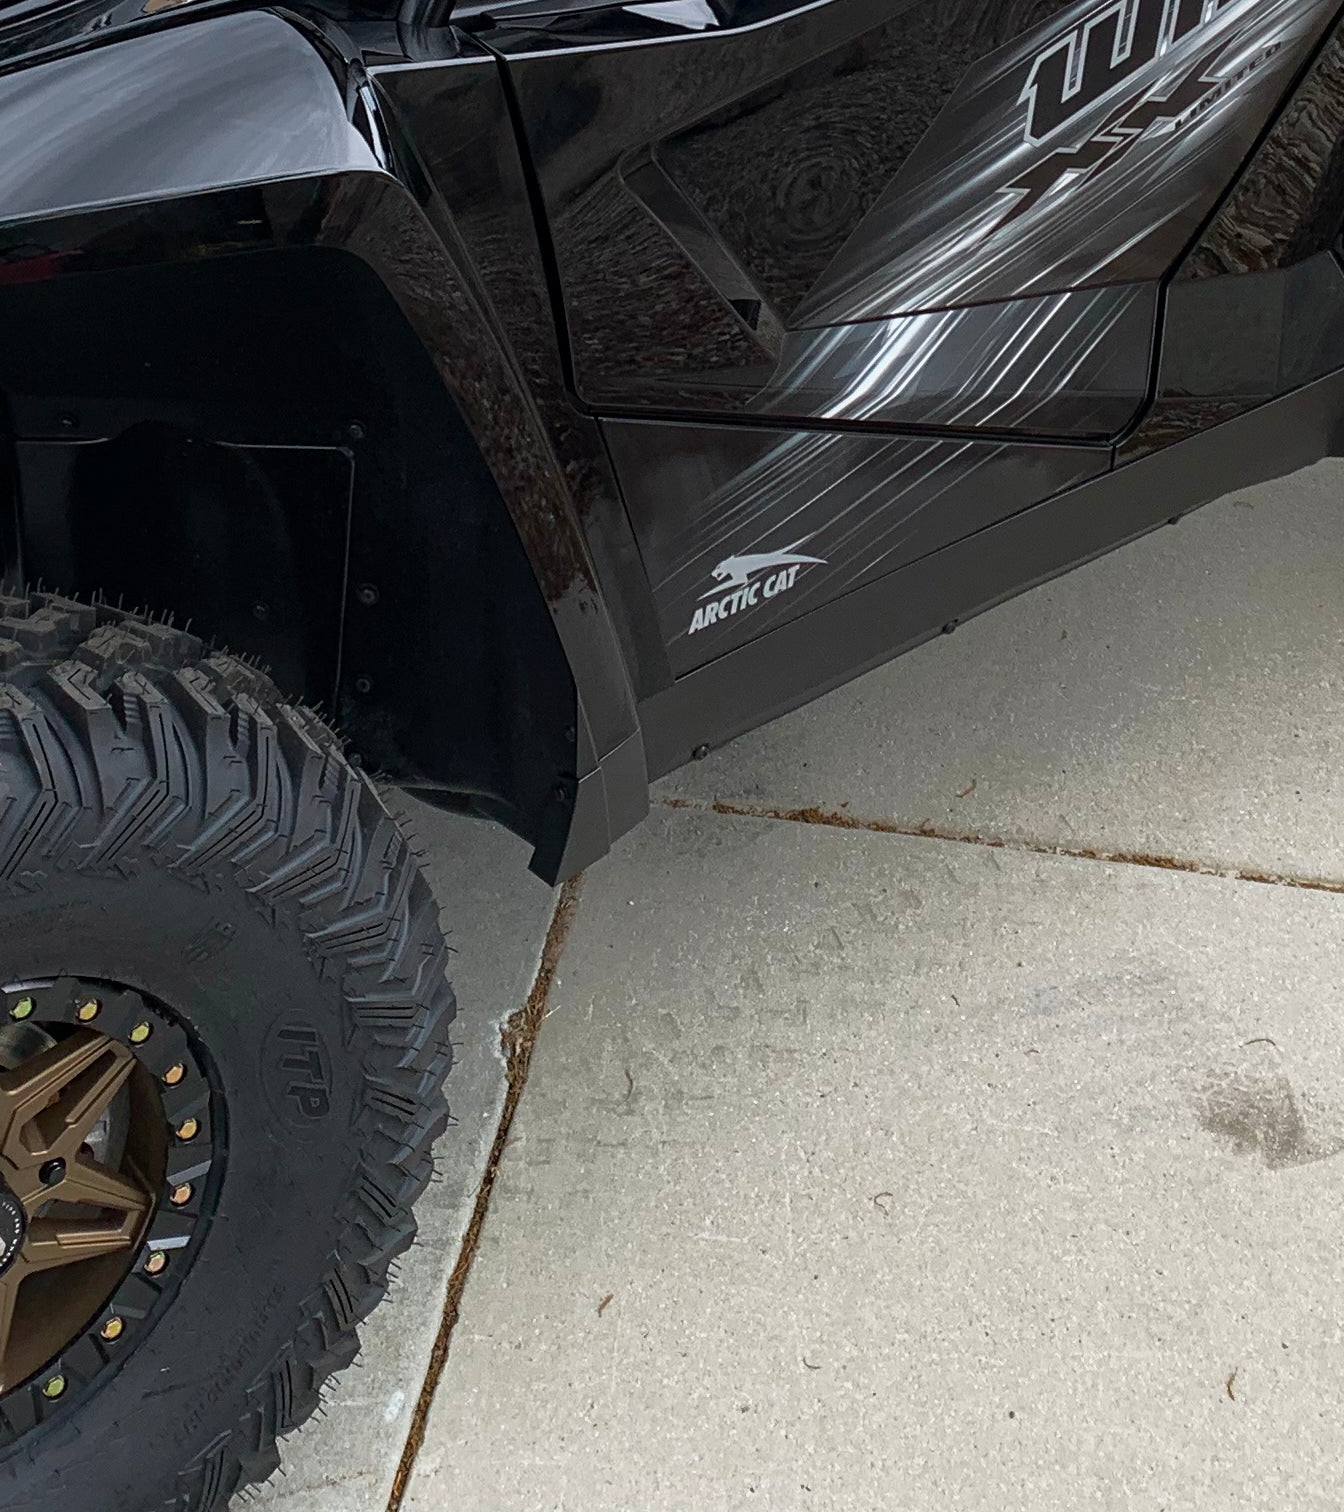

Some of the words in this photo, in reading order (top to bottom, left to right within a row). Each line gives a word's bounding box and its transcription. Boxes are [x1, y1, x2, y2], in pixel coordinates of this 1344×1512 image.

[1174, 41, 1282, 131] LIMITED
[688, 582, 760, 635] ARCTIC
[763, 564, 800, 598] CAT
[277, 1028, 330, 1119] ITP
